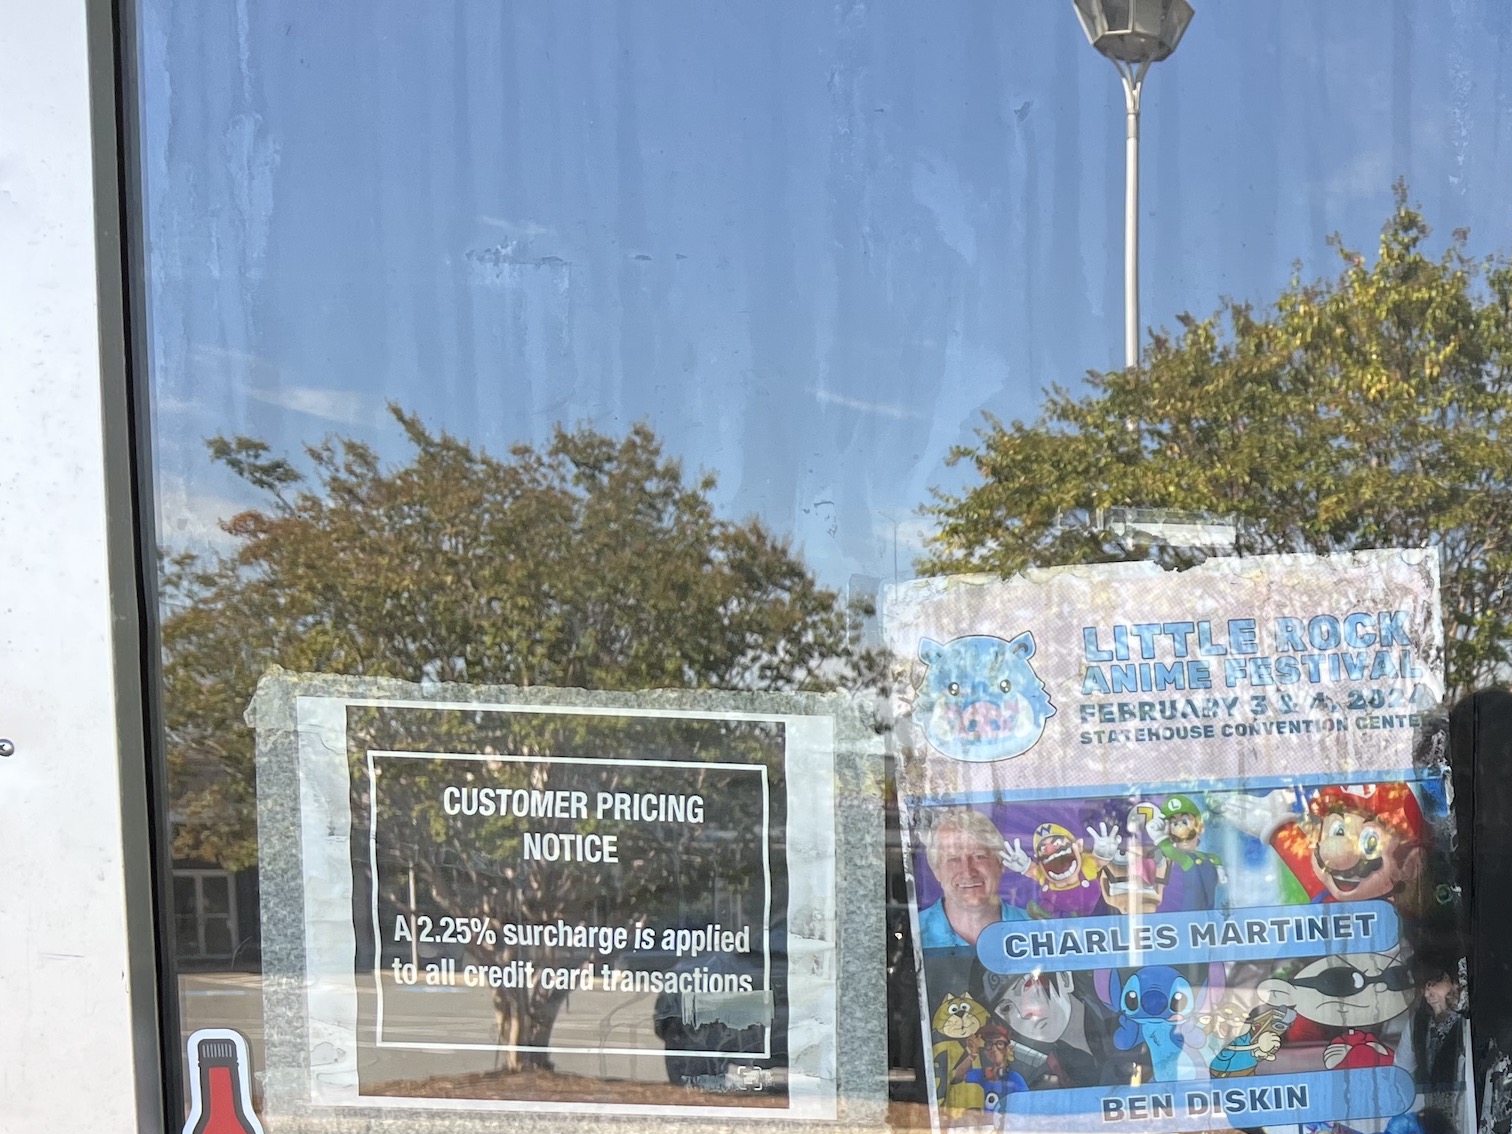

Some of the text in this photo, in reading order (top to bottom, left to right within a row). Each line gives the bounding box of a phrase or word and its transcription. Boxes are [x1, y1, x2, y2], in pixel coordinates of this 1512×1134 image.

[1083, 610, 1411, 663] LITTLE ROCK
[1080, 649, 1422, 696] ANIME FESTIVAL
[1080, 692, 1300, 725] FEBRUARY 3 &
[1079, 717, 1349, 745] STATEHOUSE CONVENTION
[444, 787, 704, 824] CUSTOMER PRICING
[523, 832, 619, 863] NOTICE
[394, 916, 750, 956] A 2.25% surcharge is applied
[1004, 913, 1377, 958] CHARLES MARTINET
[393, 958, 753, 994] to all credit card transactions
[1102, 1085, 1309, 1122] BEN DISKIN
